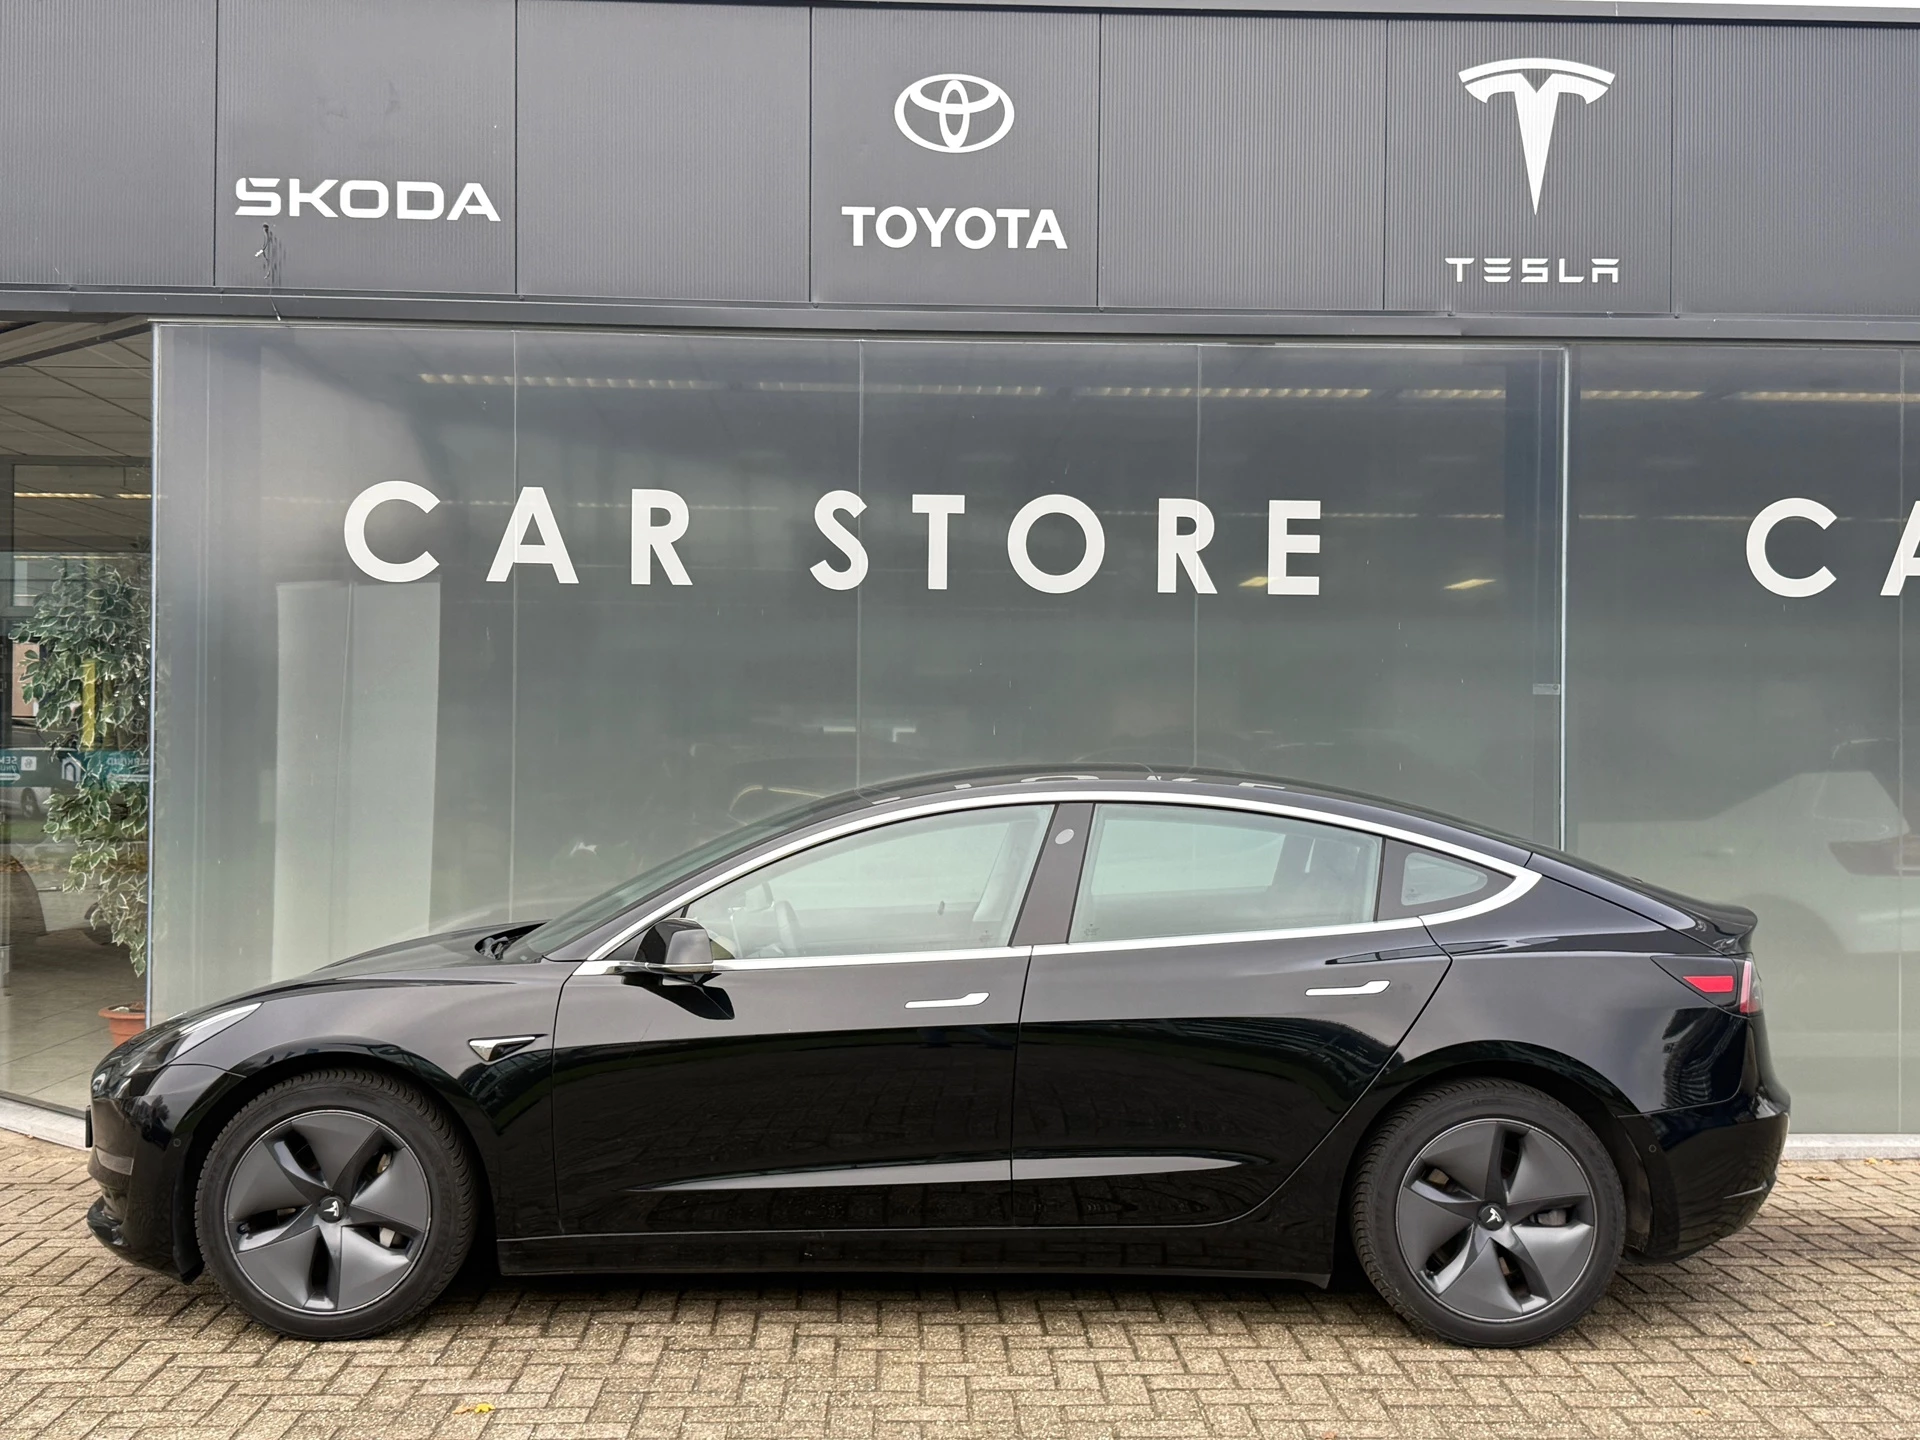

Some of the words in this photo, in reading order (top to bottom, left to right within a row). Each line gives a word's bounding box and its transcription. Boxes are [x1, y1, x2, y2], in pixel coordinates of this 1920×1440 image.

[841, 205, 1069, 250] TOYOTA
[1444, 257, 1620, 284] TESLA
[343, 480, 694, 586] CAR
[809, 489, 1321, 596] STORE
